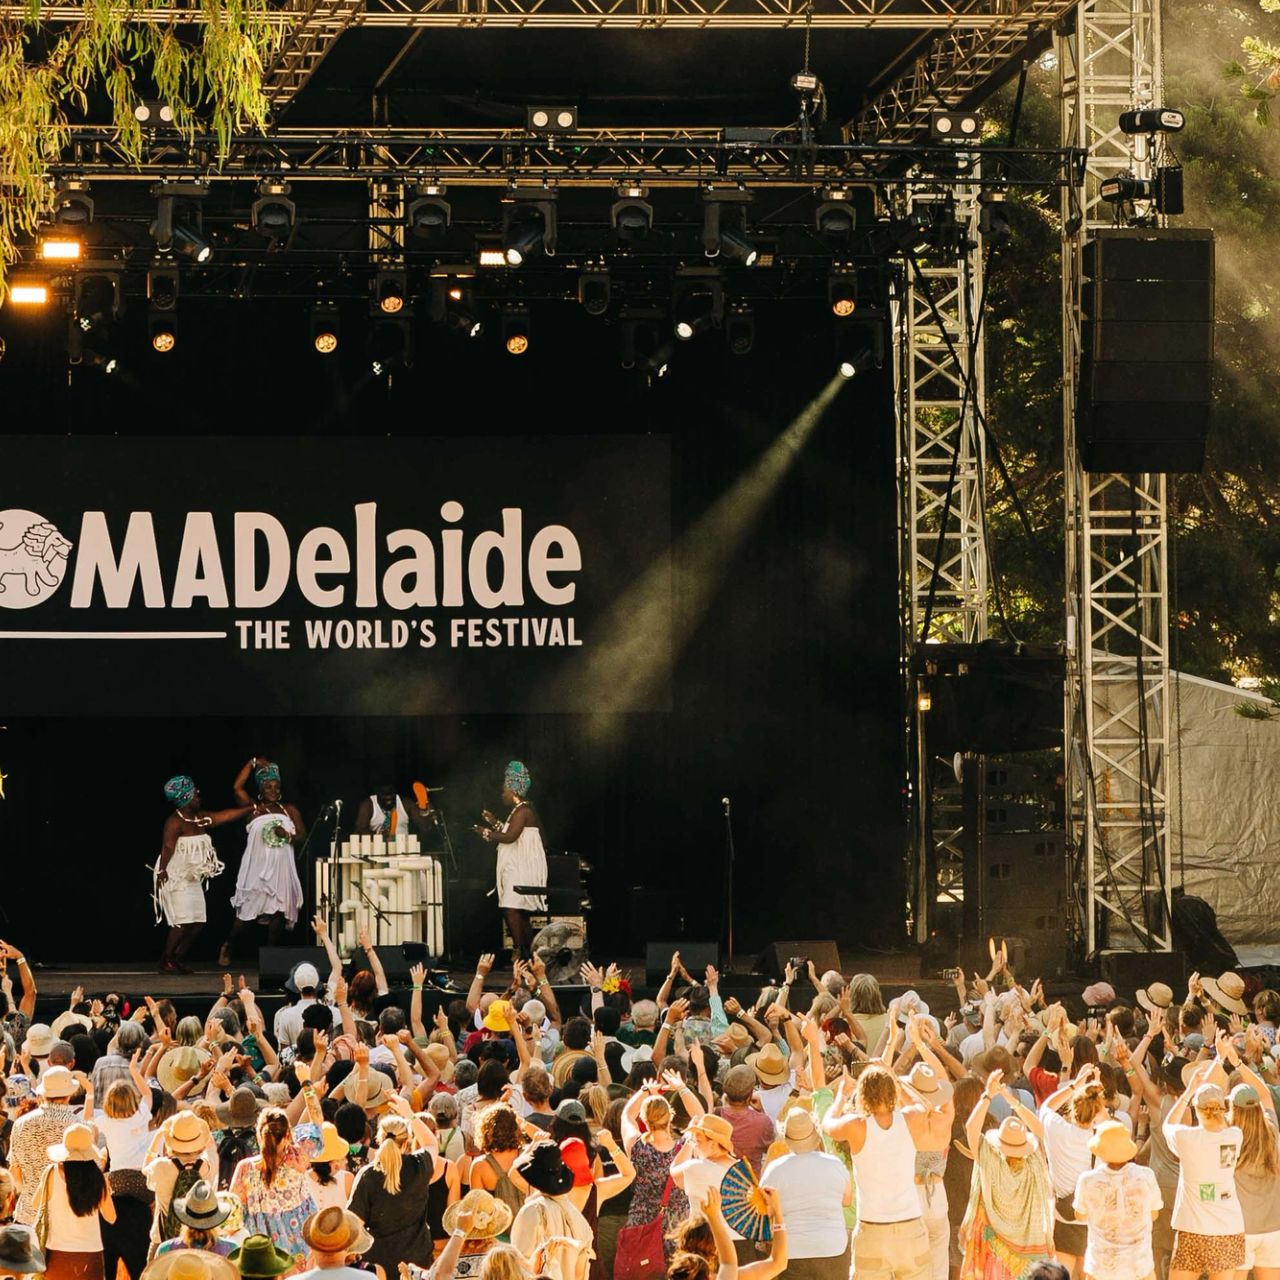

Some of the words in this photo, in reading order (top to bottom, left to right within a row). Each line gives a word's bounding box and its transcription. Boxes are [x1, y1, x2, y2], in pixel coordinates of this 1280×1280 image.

[235, 620, 291, 649] THE
[305, 618, 437, 649] WORLD'S
[449, 616, 583, 648] FESTIVAL
